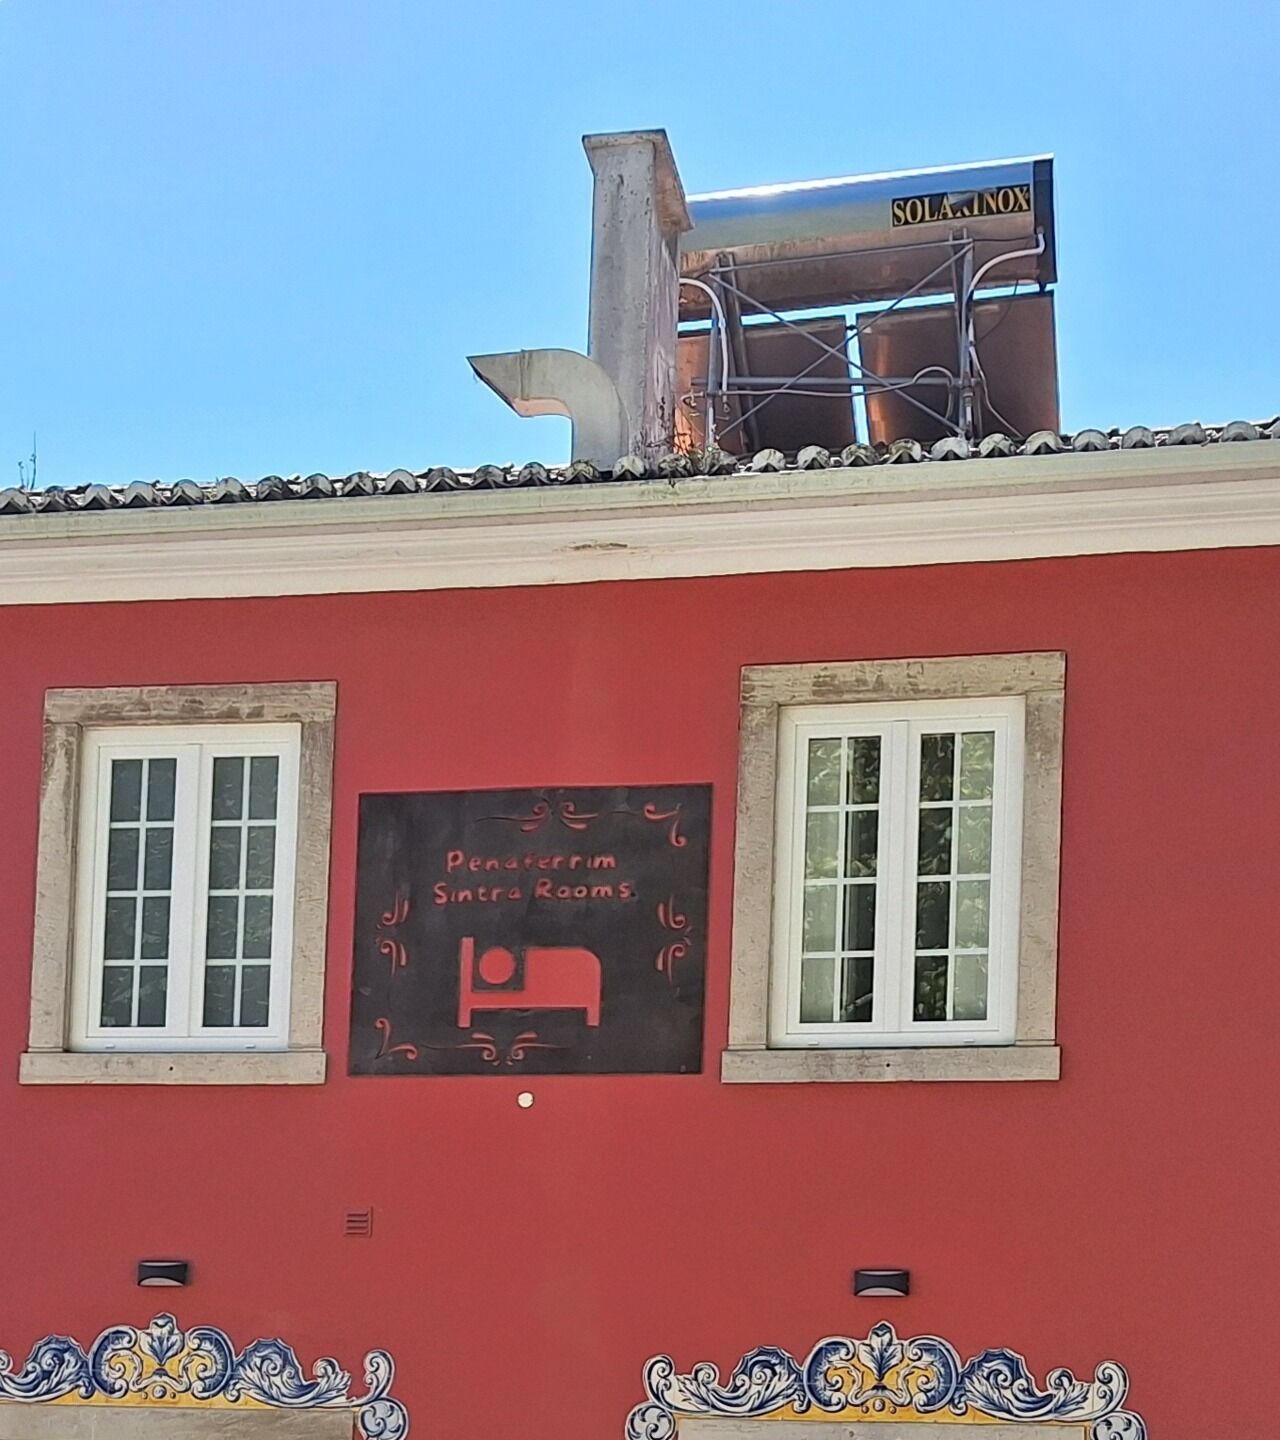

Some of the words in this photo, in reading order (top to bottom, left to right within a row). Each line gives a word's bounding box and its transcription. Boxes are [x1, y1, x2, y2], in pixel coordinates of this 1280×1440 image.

[446, 849, 617, 874] Penaferrim
[433, 881, 523, 905] Sintra
[534, 878, 633, 899] Rooms
